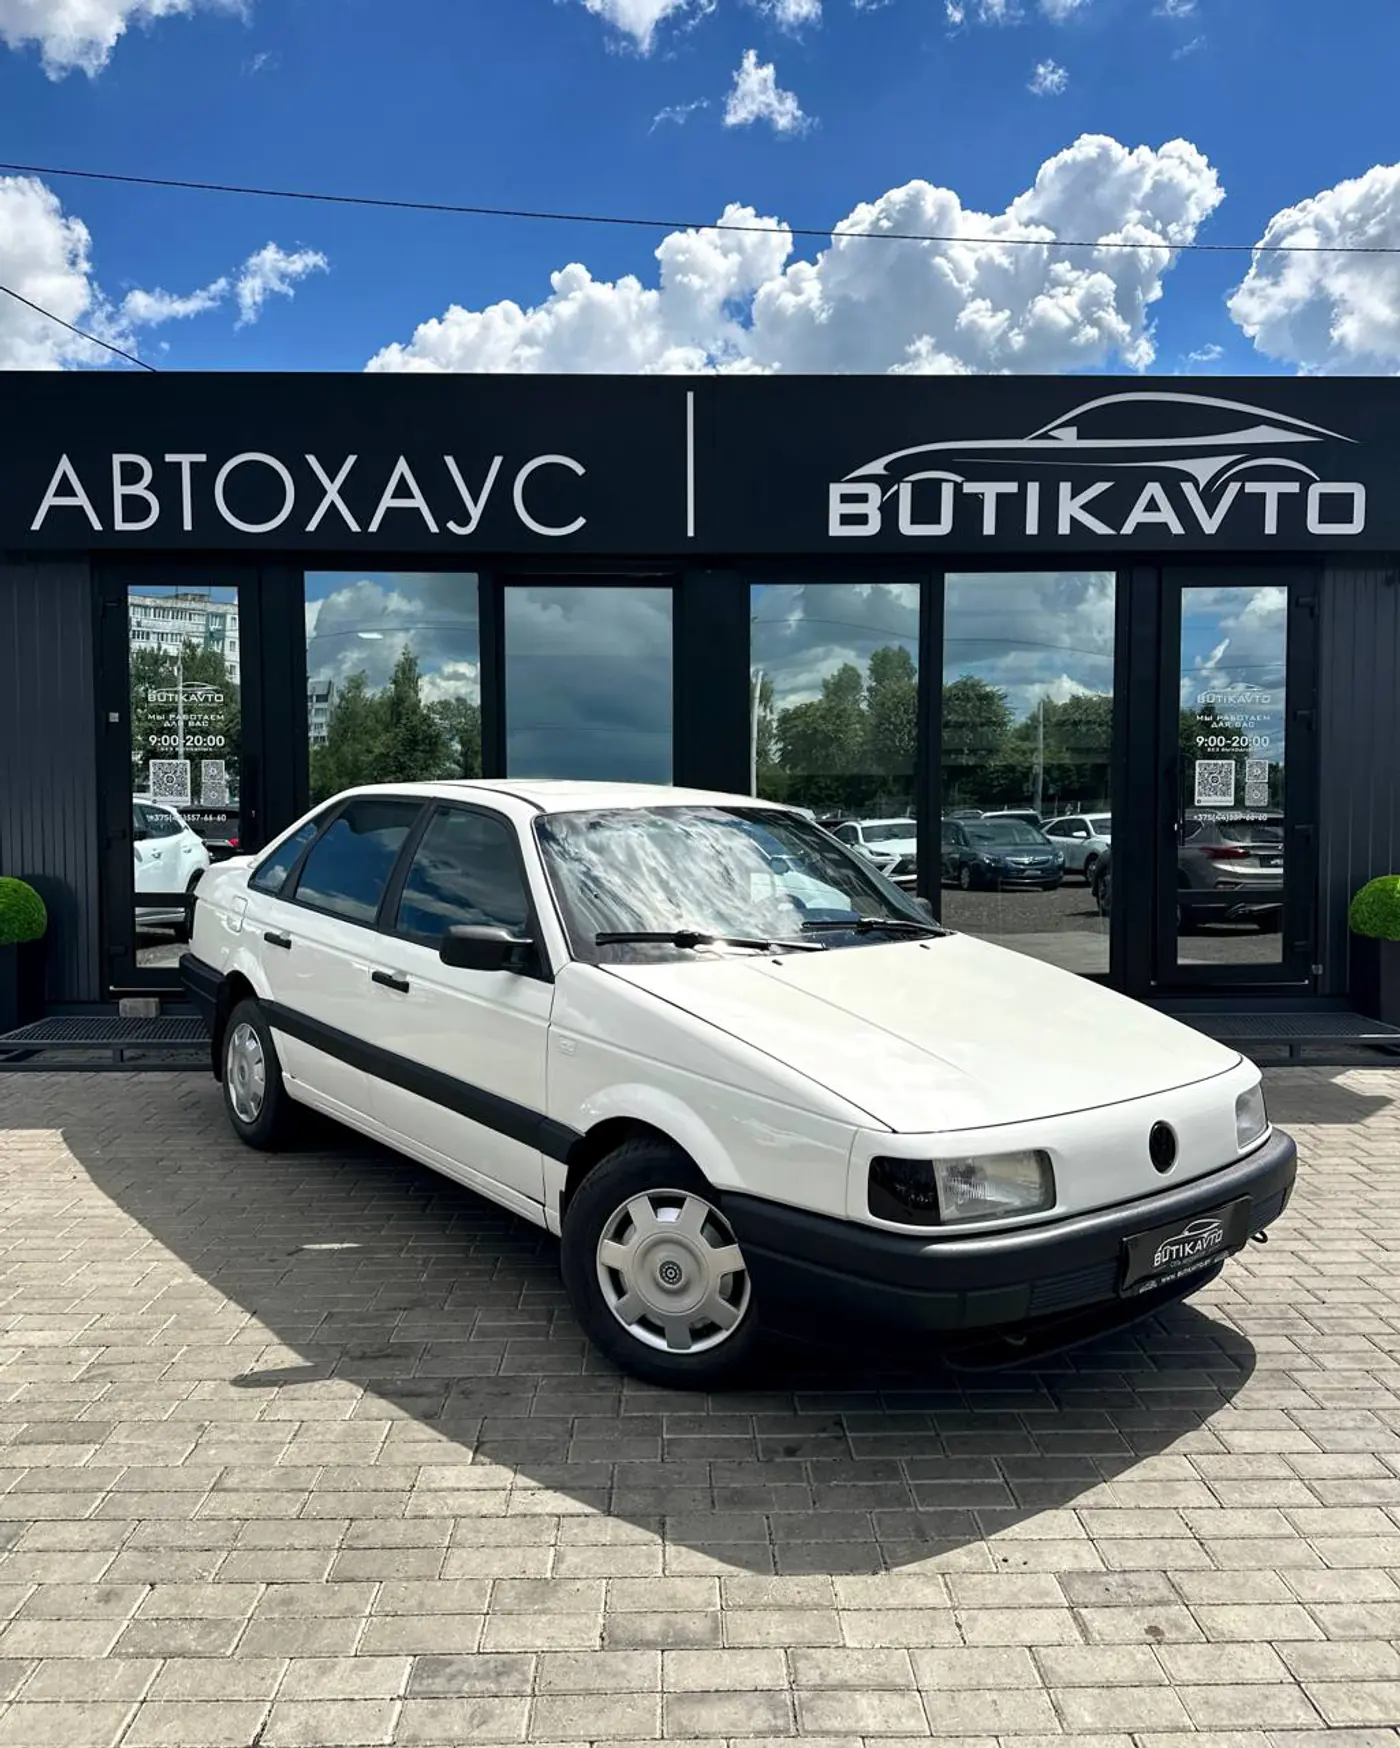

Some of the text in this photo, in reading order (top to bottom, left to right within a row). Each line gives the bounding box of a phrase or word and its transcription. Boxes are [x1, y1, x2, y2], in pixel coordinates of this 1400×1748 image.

[30, 452, 587, 536] АВТОХАУС
[828, 480, 1366, 537] BUTIKAVTO
[147, 693, 224, 702] BUTIKAVTO
[148, 735, 225, 747] 9:00-20:00
[1196, 735, 1270, 747] 9:00-20:00
[1153, 1229, 1224, 1267] BUTIKAVTO
